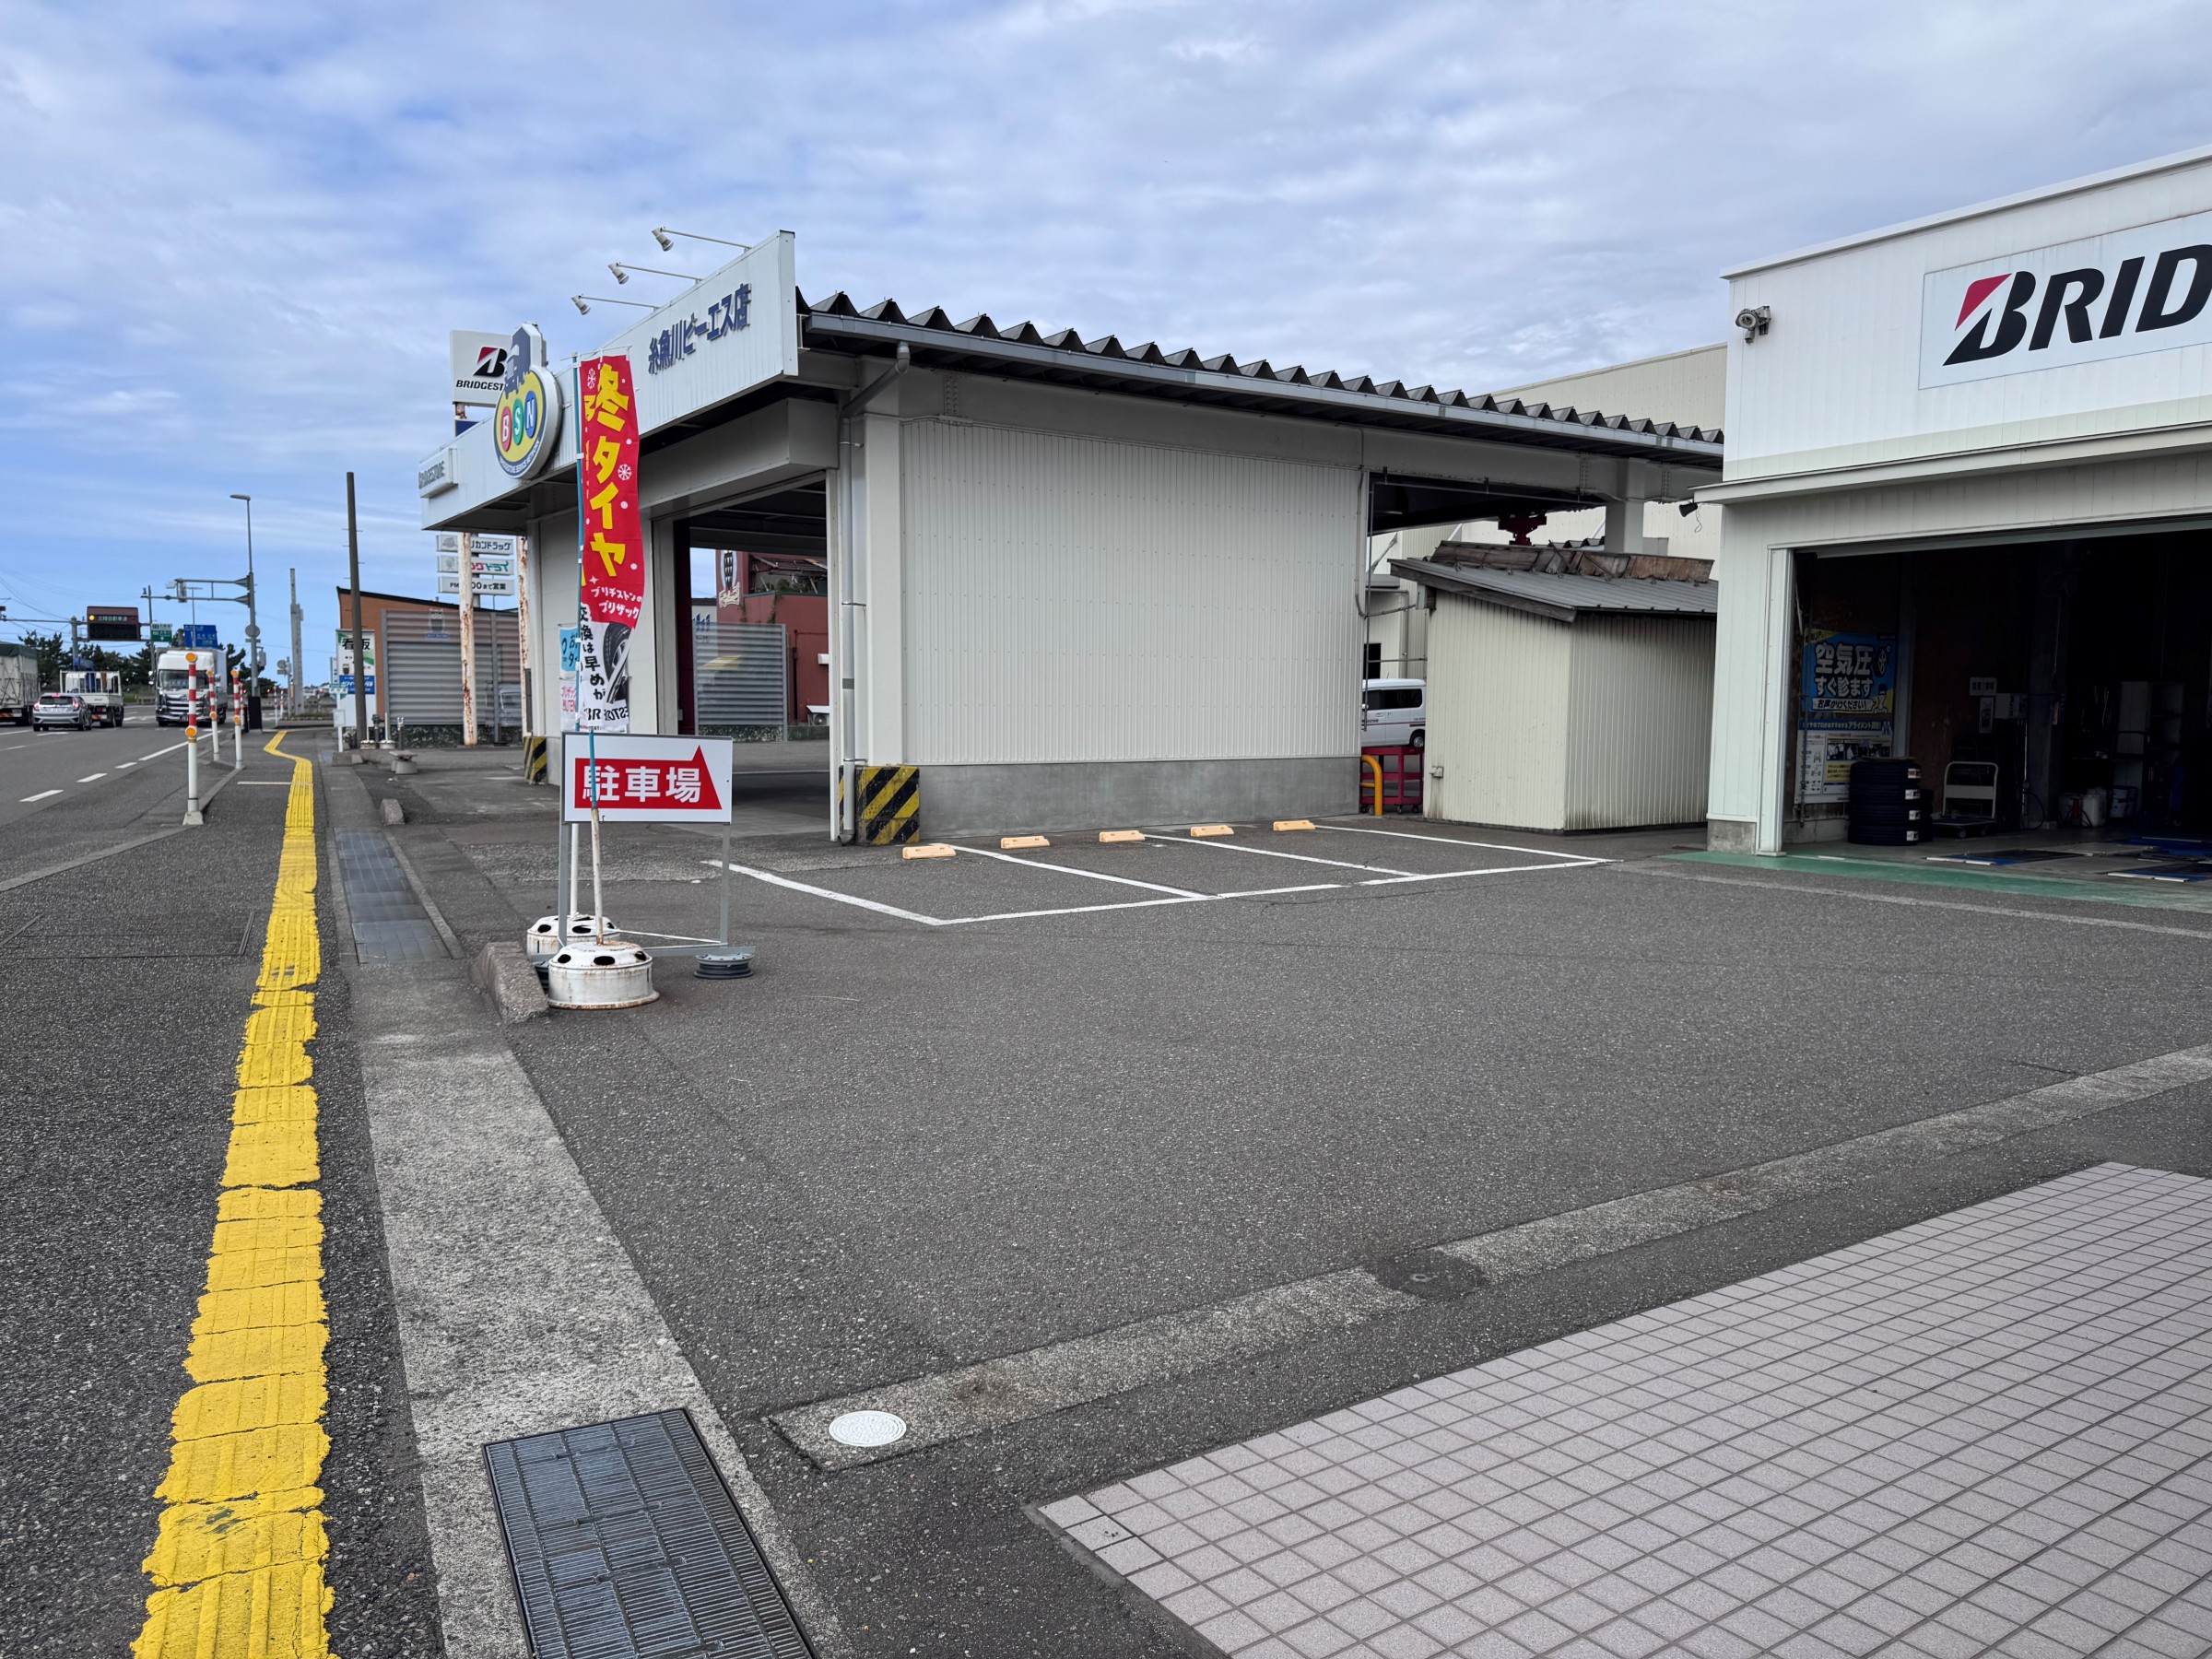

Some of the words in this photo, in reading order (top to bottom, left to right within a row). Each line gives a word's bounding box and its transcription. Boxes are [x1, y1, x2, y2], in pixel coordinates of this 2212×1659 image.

[1942, 243, 2212, 367] BRID
[648, 283, 751, 375] 糸魚川ビーエス店
[502, 397, 535, 442] BSN
[590, 363, 629, 577] 冬タイヤ
[1816, 643, 1875, 676] 空気圧
[1815, 676, 1874, 698] すぐ診ます
[582, 764, 701, 804] 駐車場
